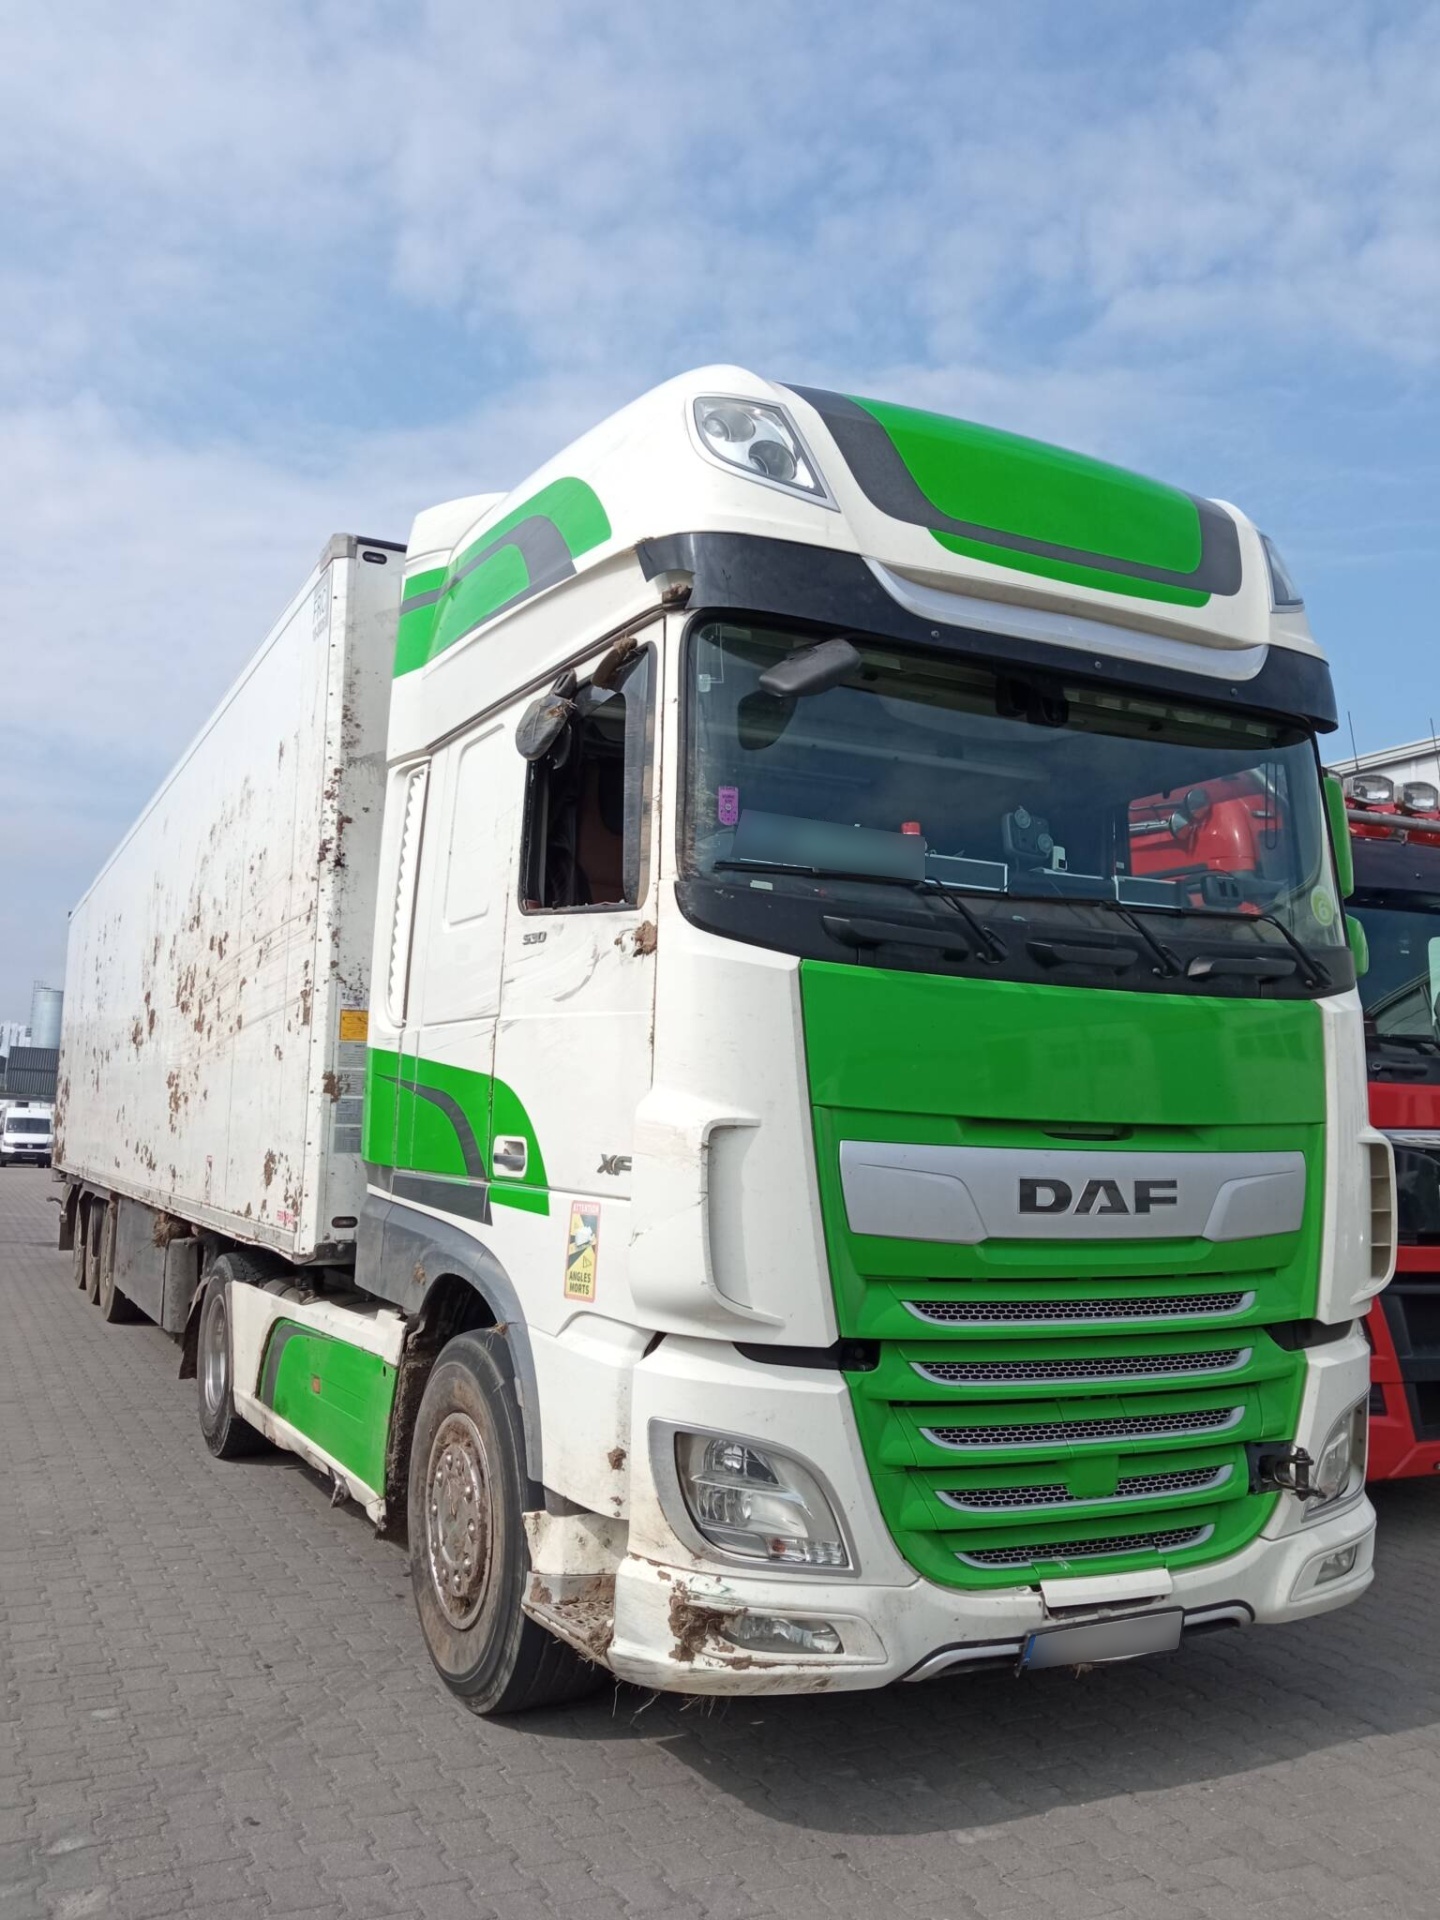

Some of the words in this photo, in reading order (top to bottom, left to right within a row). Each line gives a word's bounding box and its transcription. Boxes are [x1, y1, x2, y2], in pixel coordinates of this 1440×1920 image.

[522, 931, 547, 945] 530
[597, 1153, 632, 1176] XF
[1018, 1177, 1178, 1214] DAF
[569, 1271, 592, 1283] ANGLES
[569, 1282, 590, 1295] MORTS
